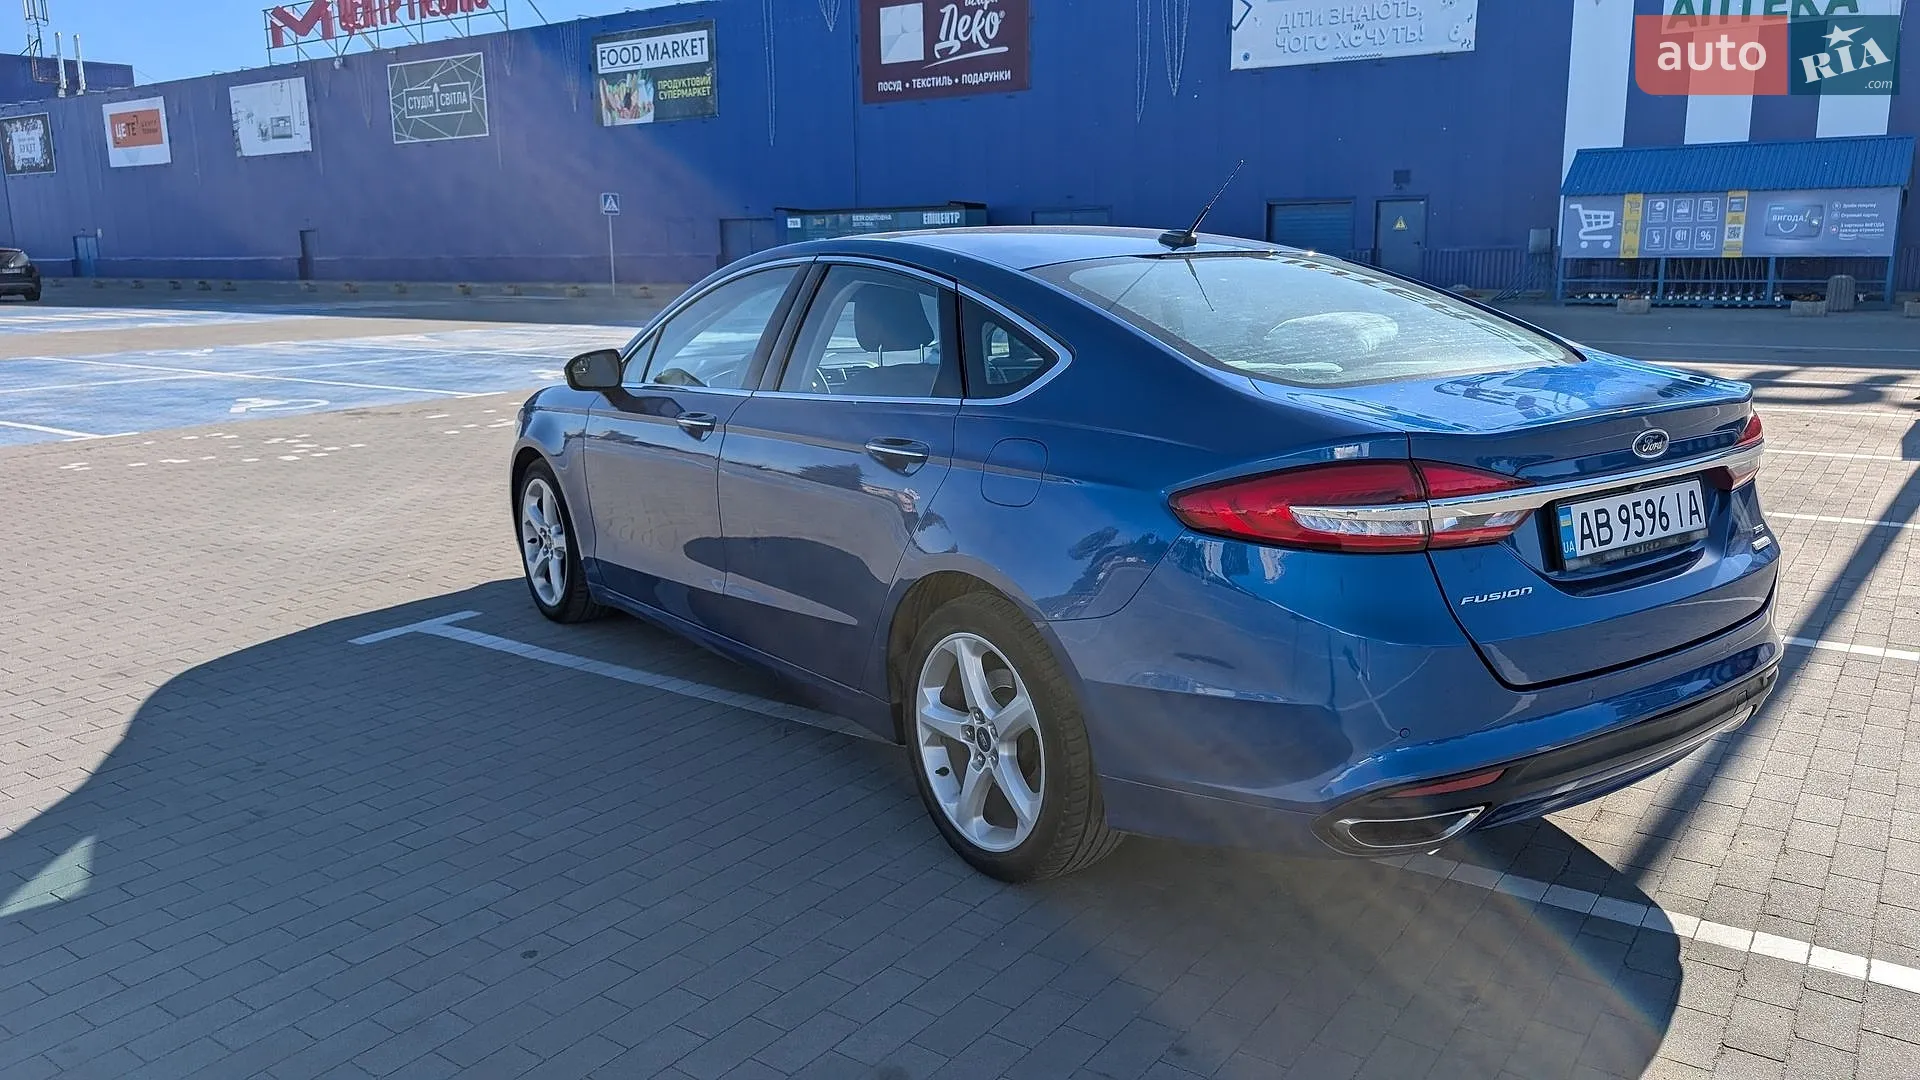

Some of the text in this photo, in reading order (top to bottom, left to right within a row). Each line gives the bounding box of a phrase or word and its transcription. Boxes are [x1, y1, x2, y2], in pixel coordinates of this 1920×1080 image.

[934, 4, 1002, 58] Деко
[1275, 10, 1324, 35] ДІТИ
[1275, 24, 1424, 53] ЧОГО ХОЧУТЬ!
[600, 37, 705, 67] FOOD MARKET
[657, 73, 712, 89] ПРОДУКТОВИЙ
[877, 70, 1011, 93] ПОСУД ТЕКСТИЛЬ ПОДАРУНКИ
[407, 91, 468, 110] СТУДІЯ СВІТЛА
[658, 86, 711, 100] СУПЕРМАРКЕТ
[922, 211, 961, 225] ЕПІЦЕНТР
[1642, 434, 1664, 452] Ford
[1579, 489, 1703, 551] AB 9596 IA
[1563, 541, 1575, 554] UA
[1460, 586, 1533, 606] FUSION
